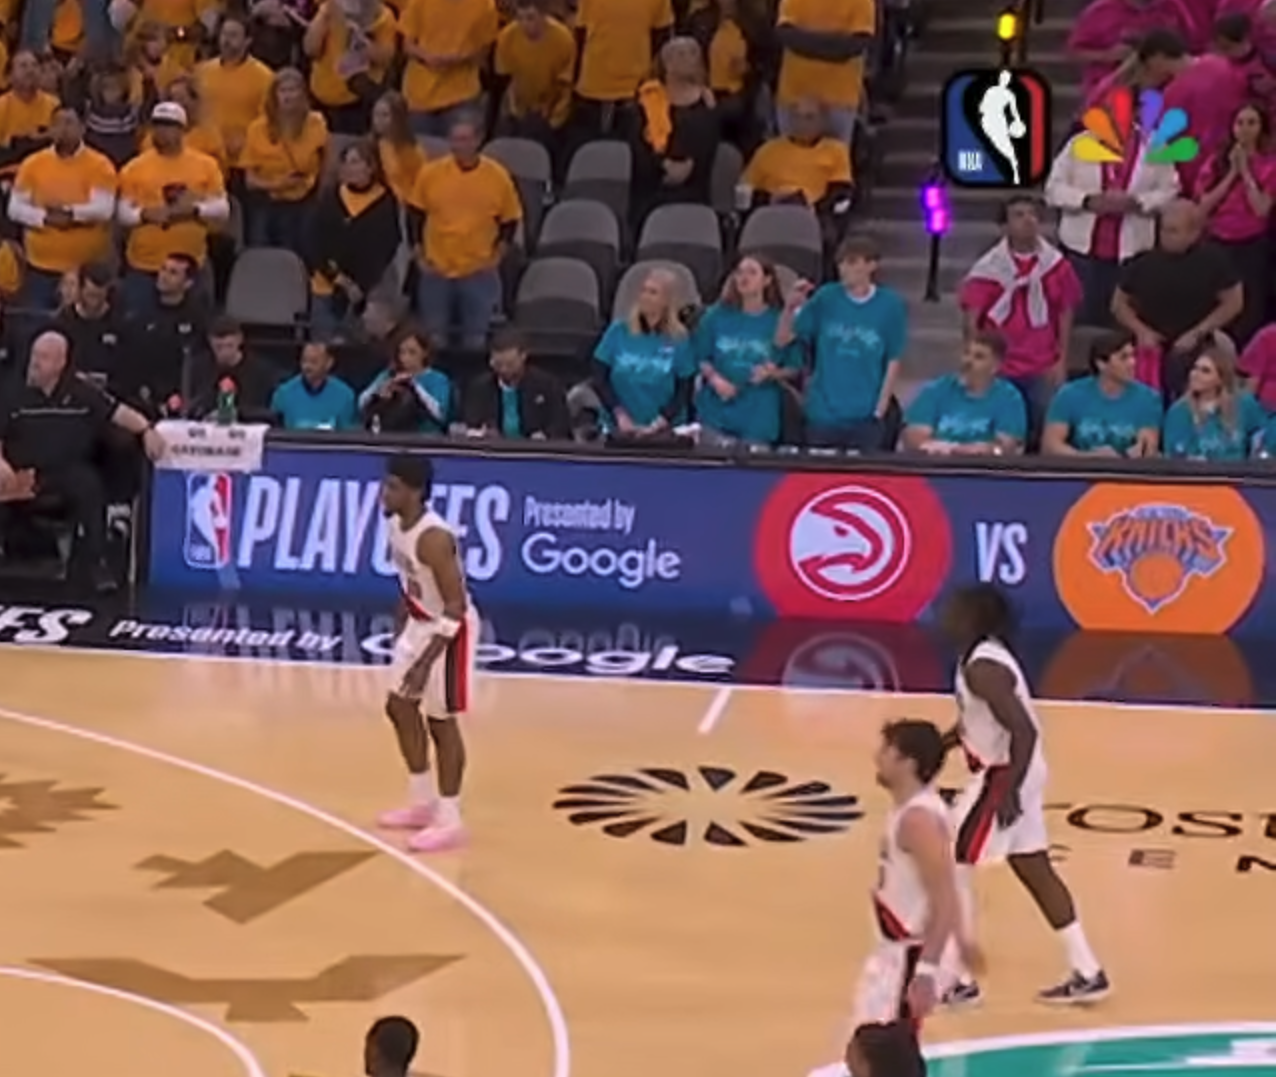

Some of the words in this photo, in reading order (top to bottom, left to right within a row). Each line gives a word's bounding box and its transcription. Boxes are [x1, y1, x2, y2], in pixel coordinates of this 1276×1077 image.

[237, 476, 510, 581] PLAYFS
[976, 522, 1028, 584] VS
[521, 531, 681, 589] Google
[109, 619, 296, 648] Presented
[297, 630, 342, 651] by
